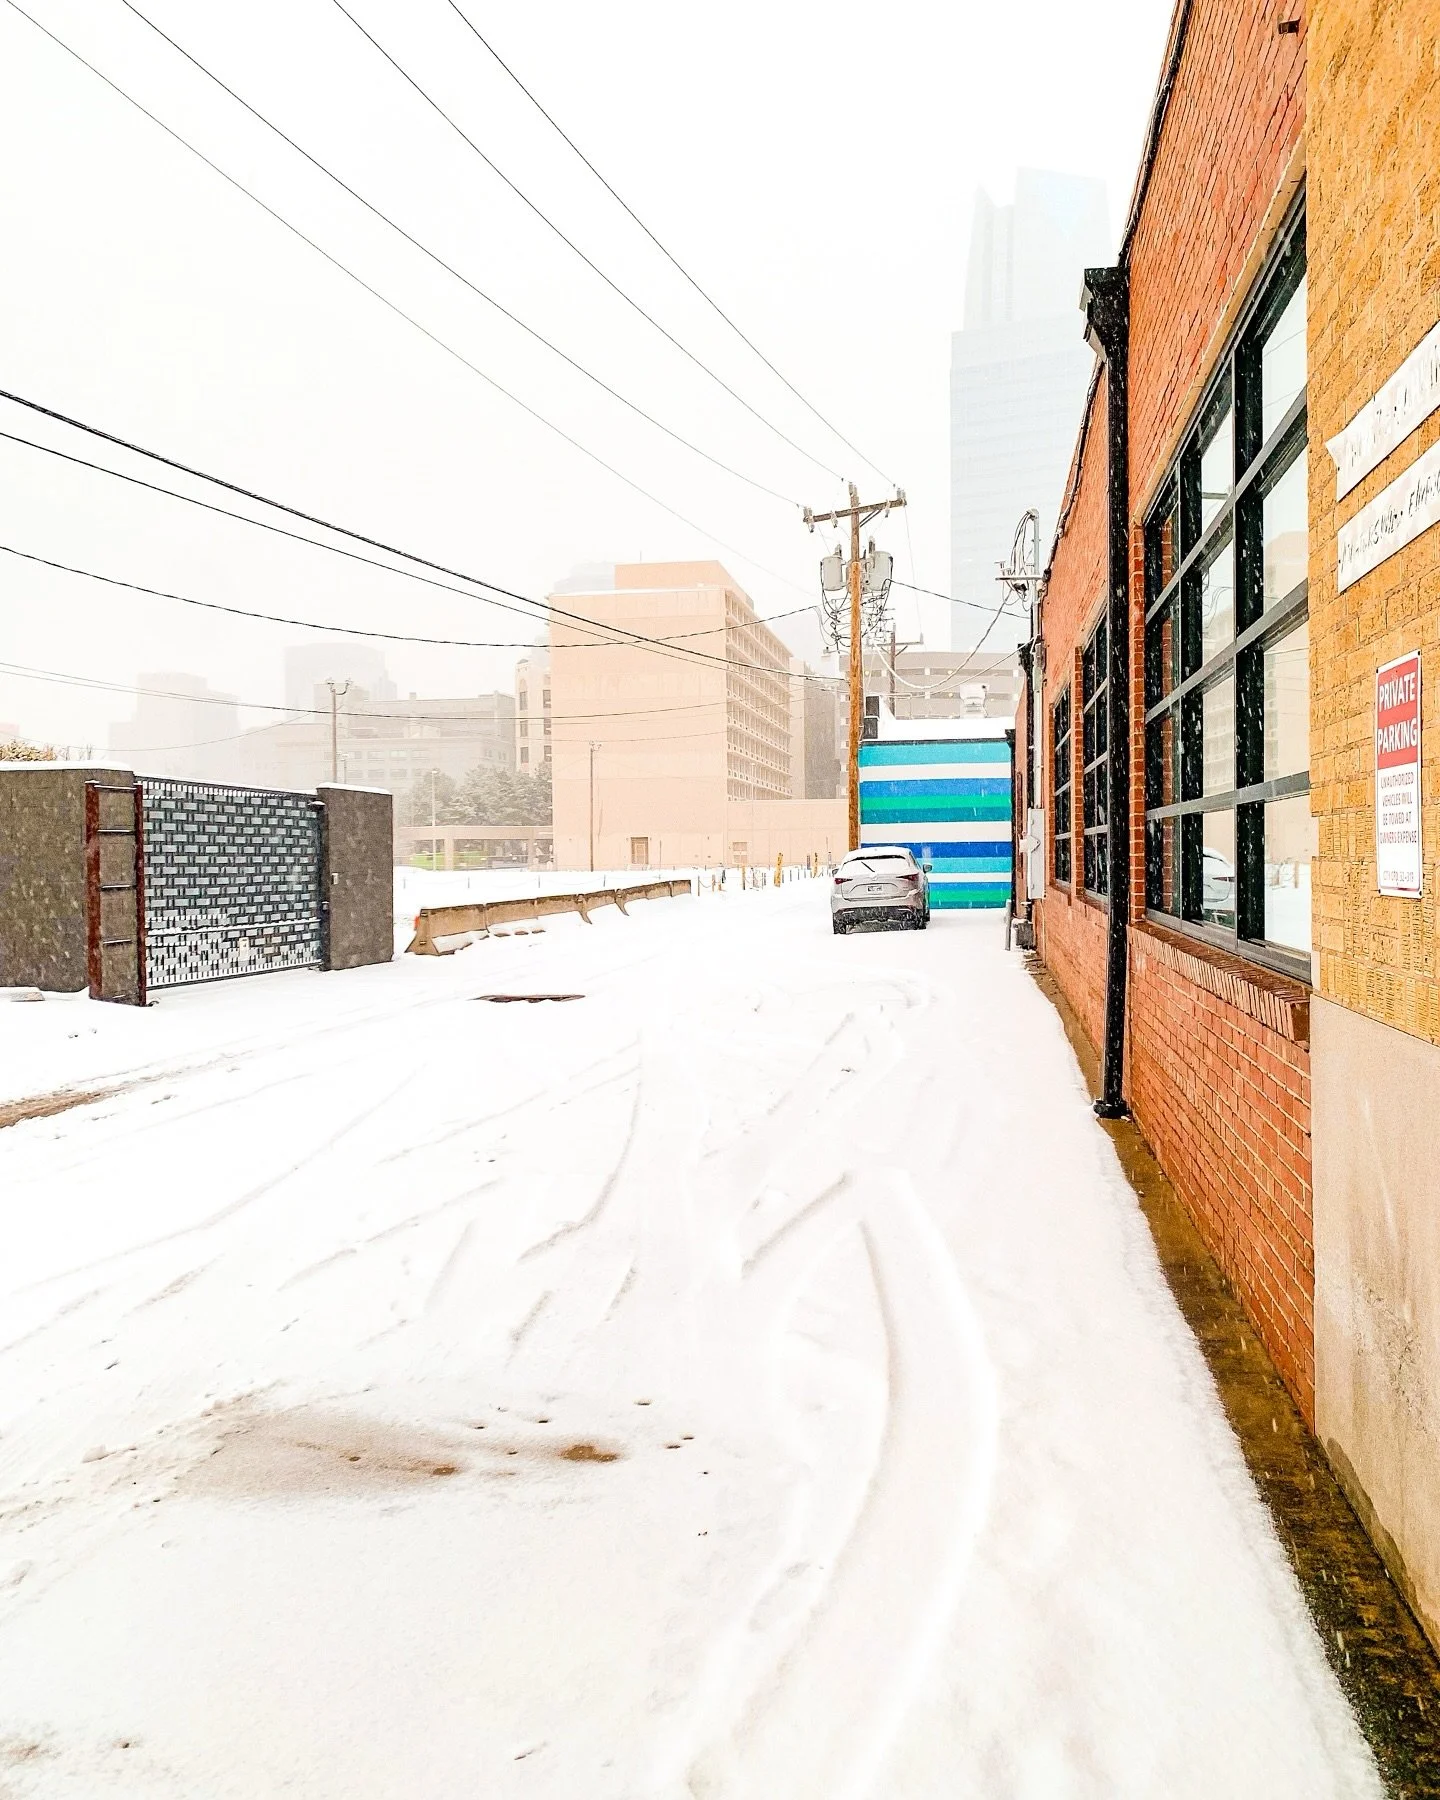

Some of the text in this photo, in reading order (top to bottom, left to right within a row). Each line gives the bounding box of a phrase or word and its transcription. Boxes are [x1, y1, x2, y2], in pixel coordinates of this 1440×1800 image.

[1379, 672, 1416, 712] PRIVATE
[1377, 717, 1417, 755] PARKING
[1381, 772, 1414, 788] UNAUTHORIZED
[1382, 792, 1412, 806] VEHICLES WILL
[1389, 811, 1404, 824] TOWED
[1405, 811, 1411, 823] AT
[1397, 830, 1416, 843] EXPENSE
